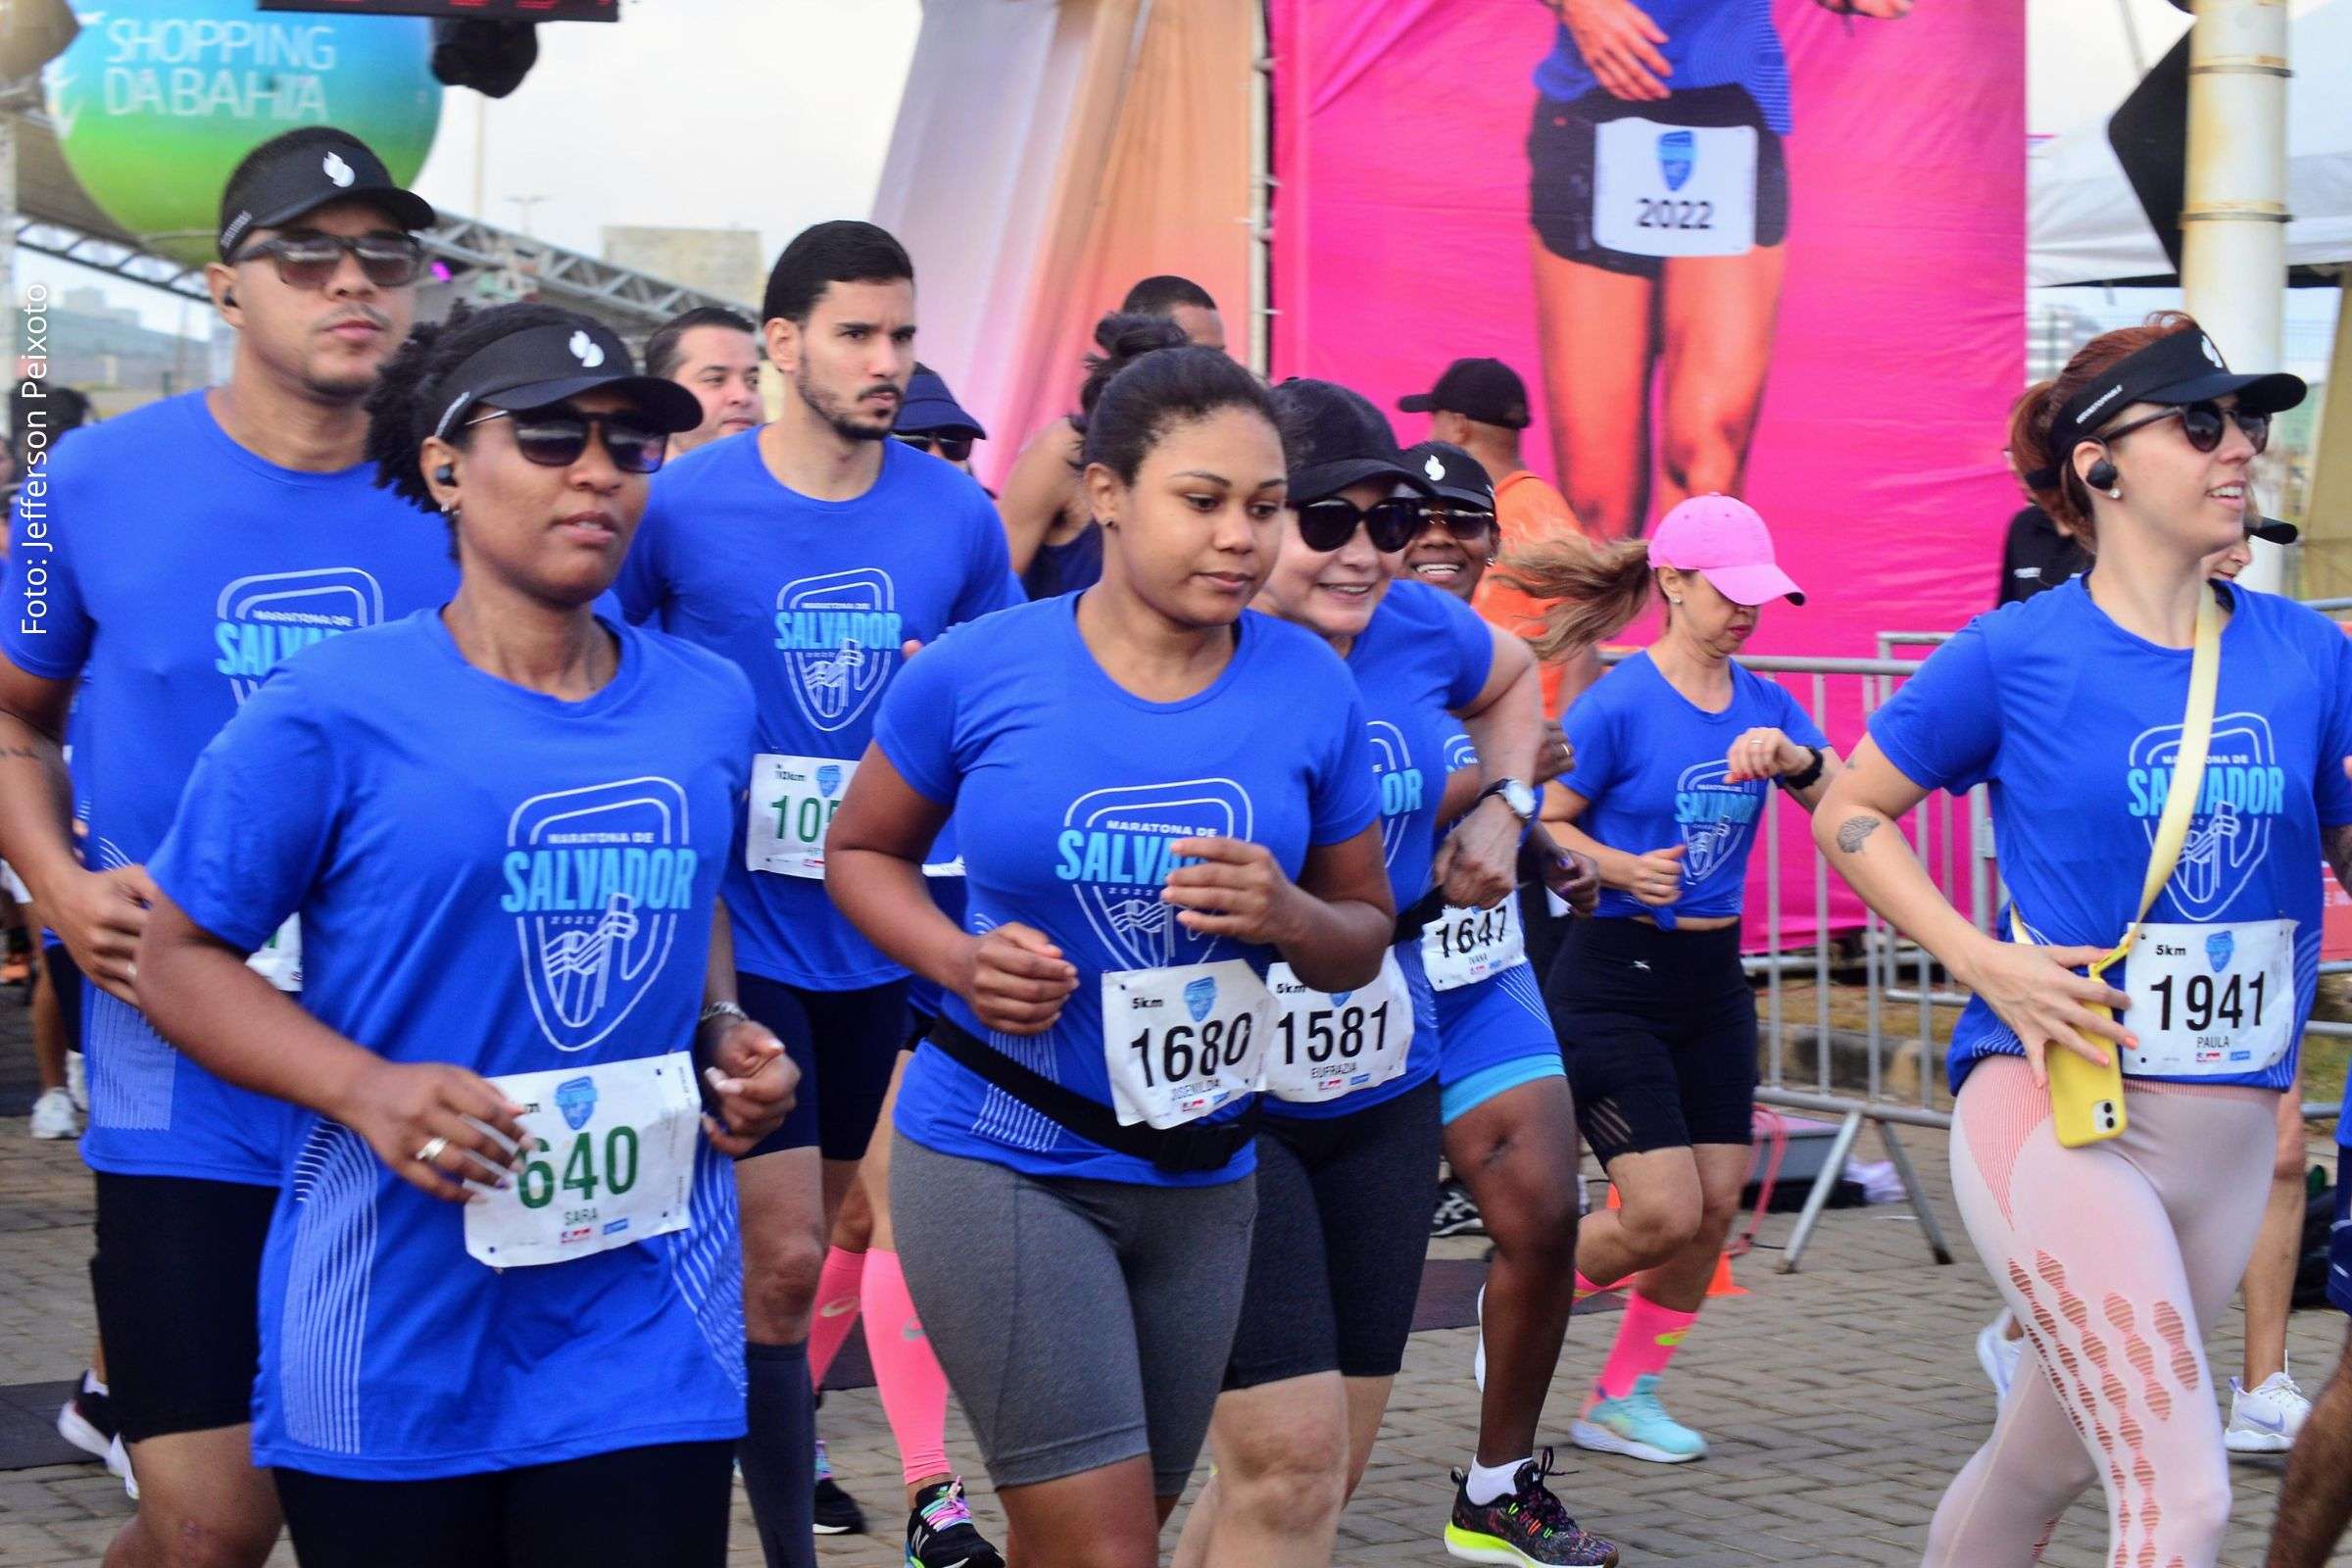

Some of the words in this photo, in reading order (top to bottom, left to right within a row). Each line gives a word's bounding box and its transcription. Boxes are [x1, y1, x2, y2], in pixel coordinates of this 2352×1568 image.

[105, 18, 336, 71] SHOPPING
[1637, 198, 1713, 229] 2022
[774, 612, 902, 650] SALVADOR
[1675, 791, 1759, 823] SALVADOR
[2127, 766, 2285, 816] SAADOR
[1106, 820, 1193, 836] MARATONA
[1196, 826, 1217, 837] DE
[501, 848, 698, 913] SALVADOR
[1108, 887, 1154, 897] 2022
[1436, 906, 1506, 958] 1647
[2155, 944, 2187, 956] 5km
[1131, 997, 1164, 1009] 5km
[1275, 983, 1305, 995] 5km
[2150, 971, 2265, 1031] 1941
[1131, 1011, 1252, 1088] 1680
[1278, 1001, 1389, 1065] 1581
[2196, 1035, 2230, 1049] PAULA
[517, 1125, 639, 1208] 640
[564, 1207, 598, 1226] SARA
